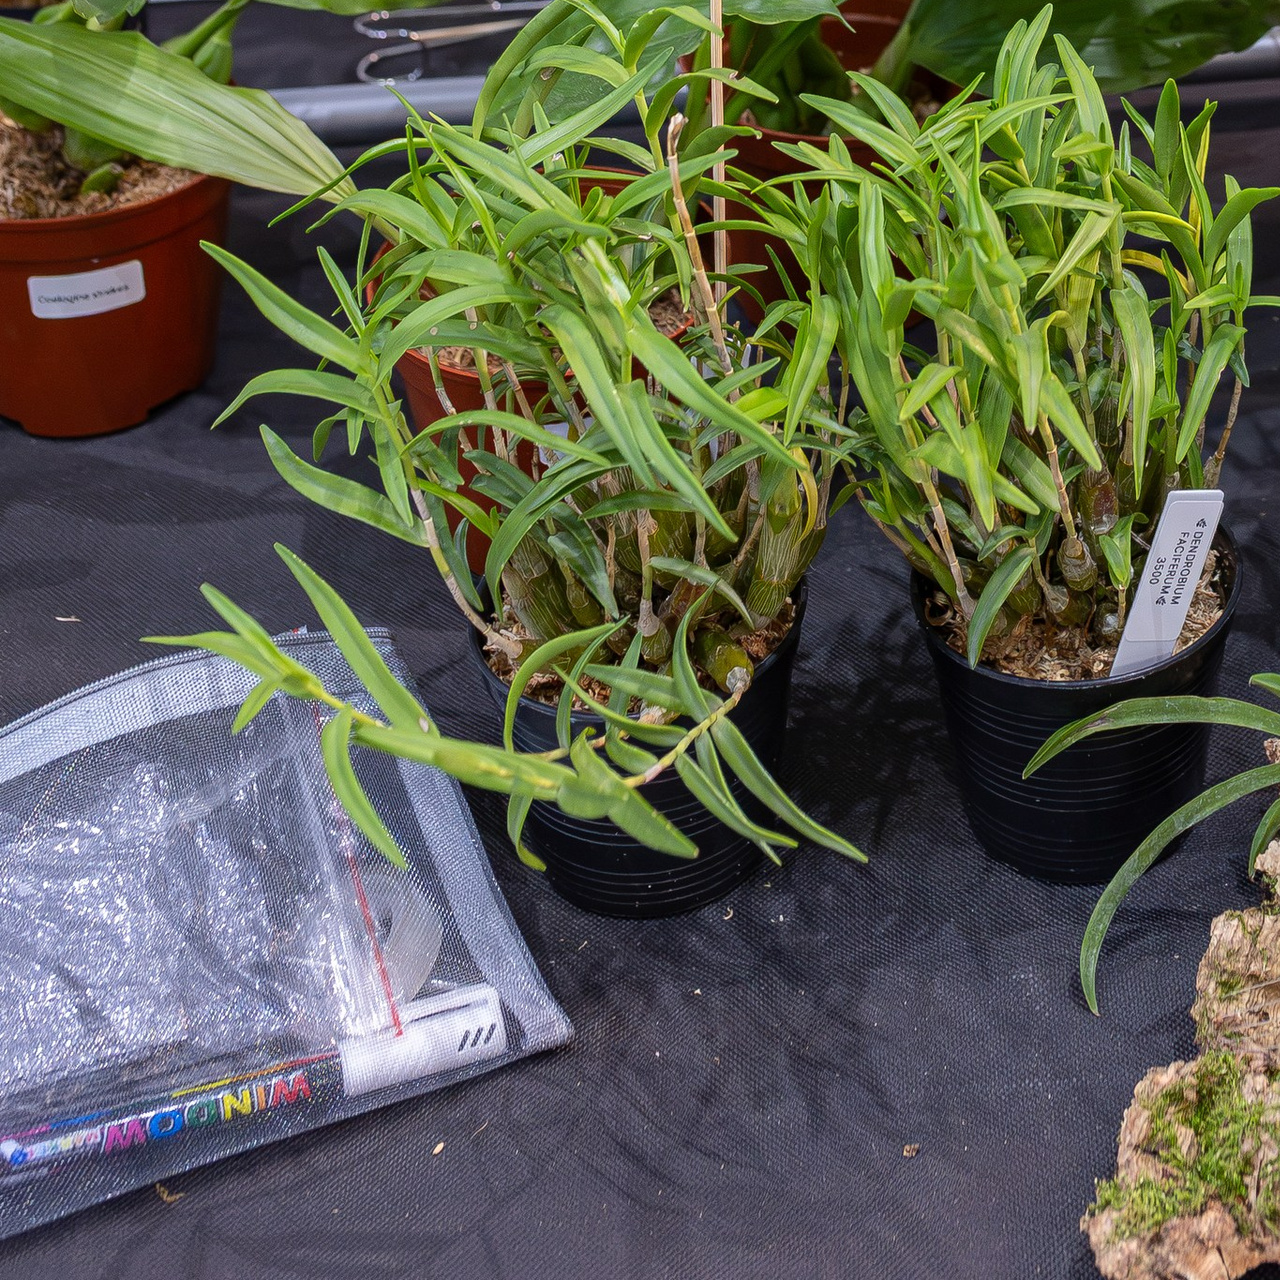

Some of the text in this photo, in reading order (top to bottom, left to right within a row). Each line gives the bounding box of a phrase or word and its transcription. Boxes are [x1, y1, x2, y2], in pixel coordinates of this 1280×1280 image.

[1149, 556, 1167, 585] 3500
[1160, 531, 1190, 595] FACIFERUM
[1170, 531, 1203, 606] DENDROBIUM
[103, 1070, 311, 1154] WINDOW
